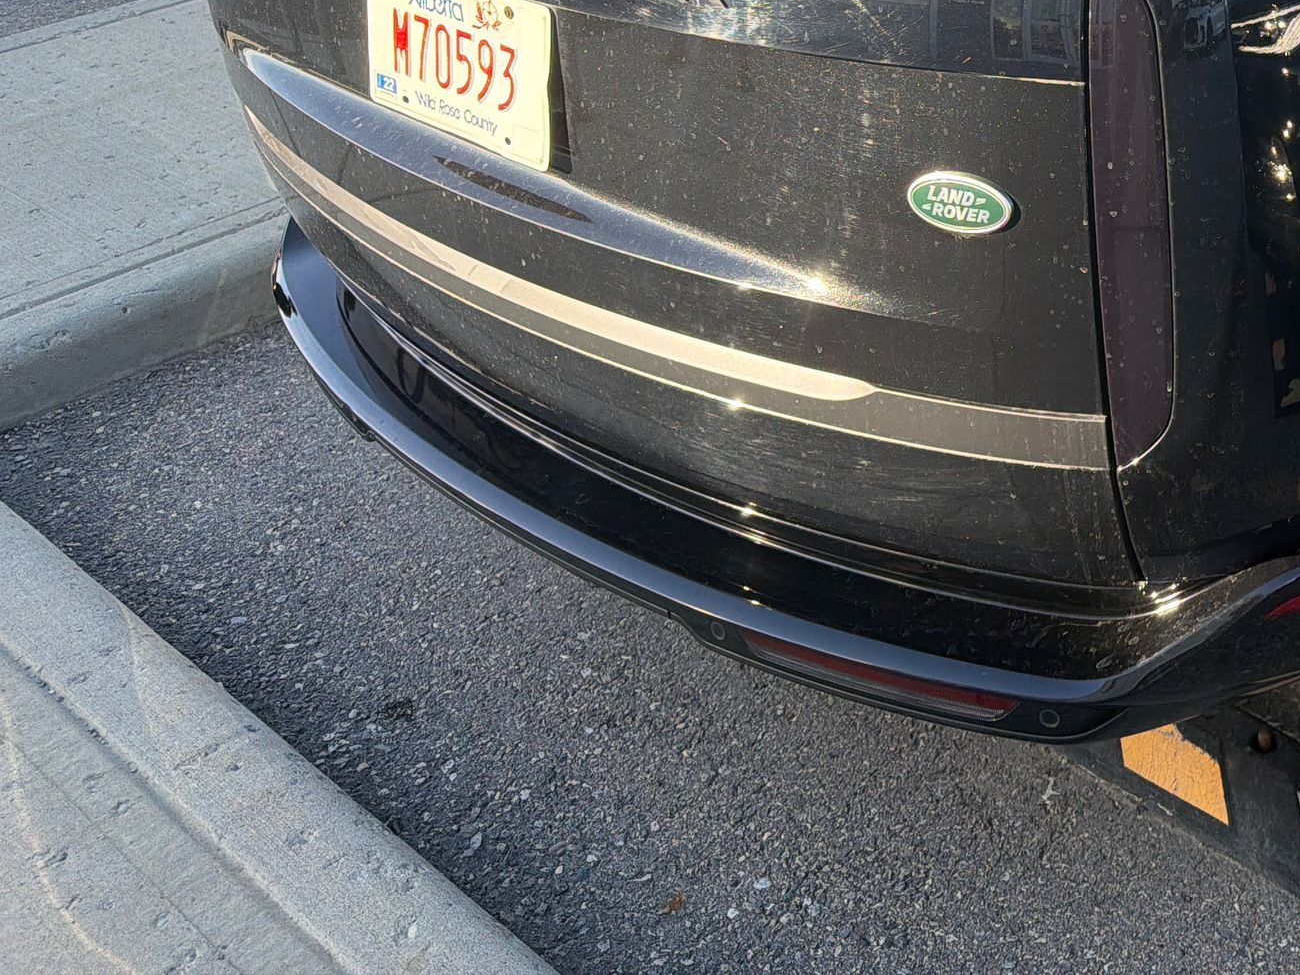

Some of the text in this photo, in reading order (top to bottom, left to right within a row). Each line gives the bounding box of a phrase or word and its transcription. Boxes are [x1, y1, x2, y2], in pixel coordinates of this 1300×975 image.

[392, 7, 517, 112] M70593
[414, 90, 499, 137] Wild Rose County
[926, 184, 976, 207] LAND
[931, 202, 991, 224] ROVER
